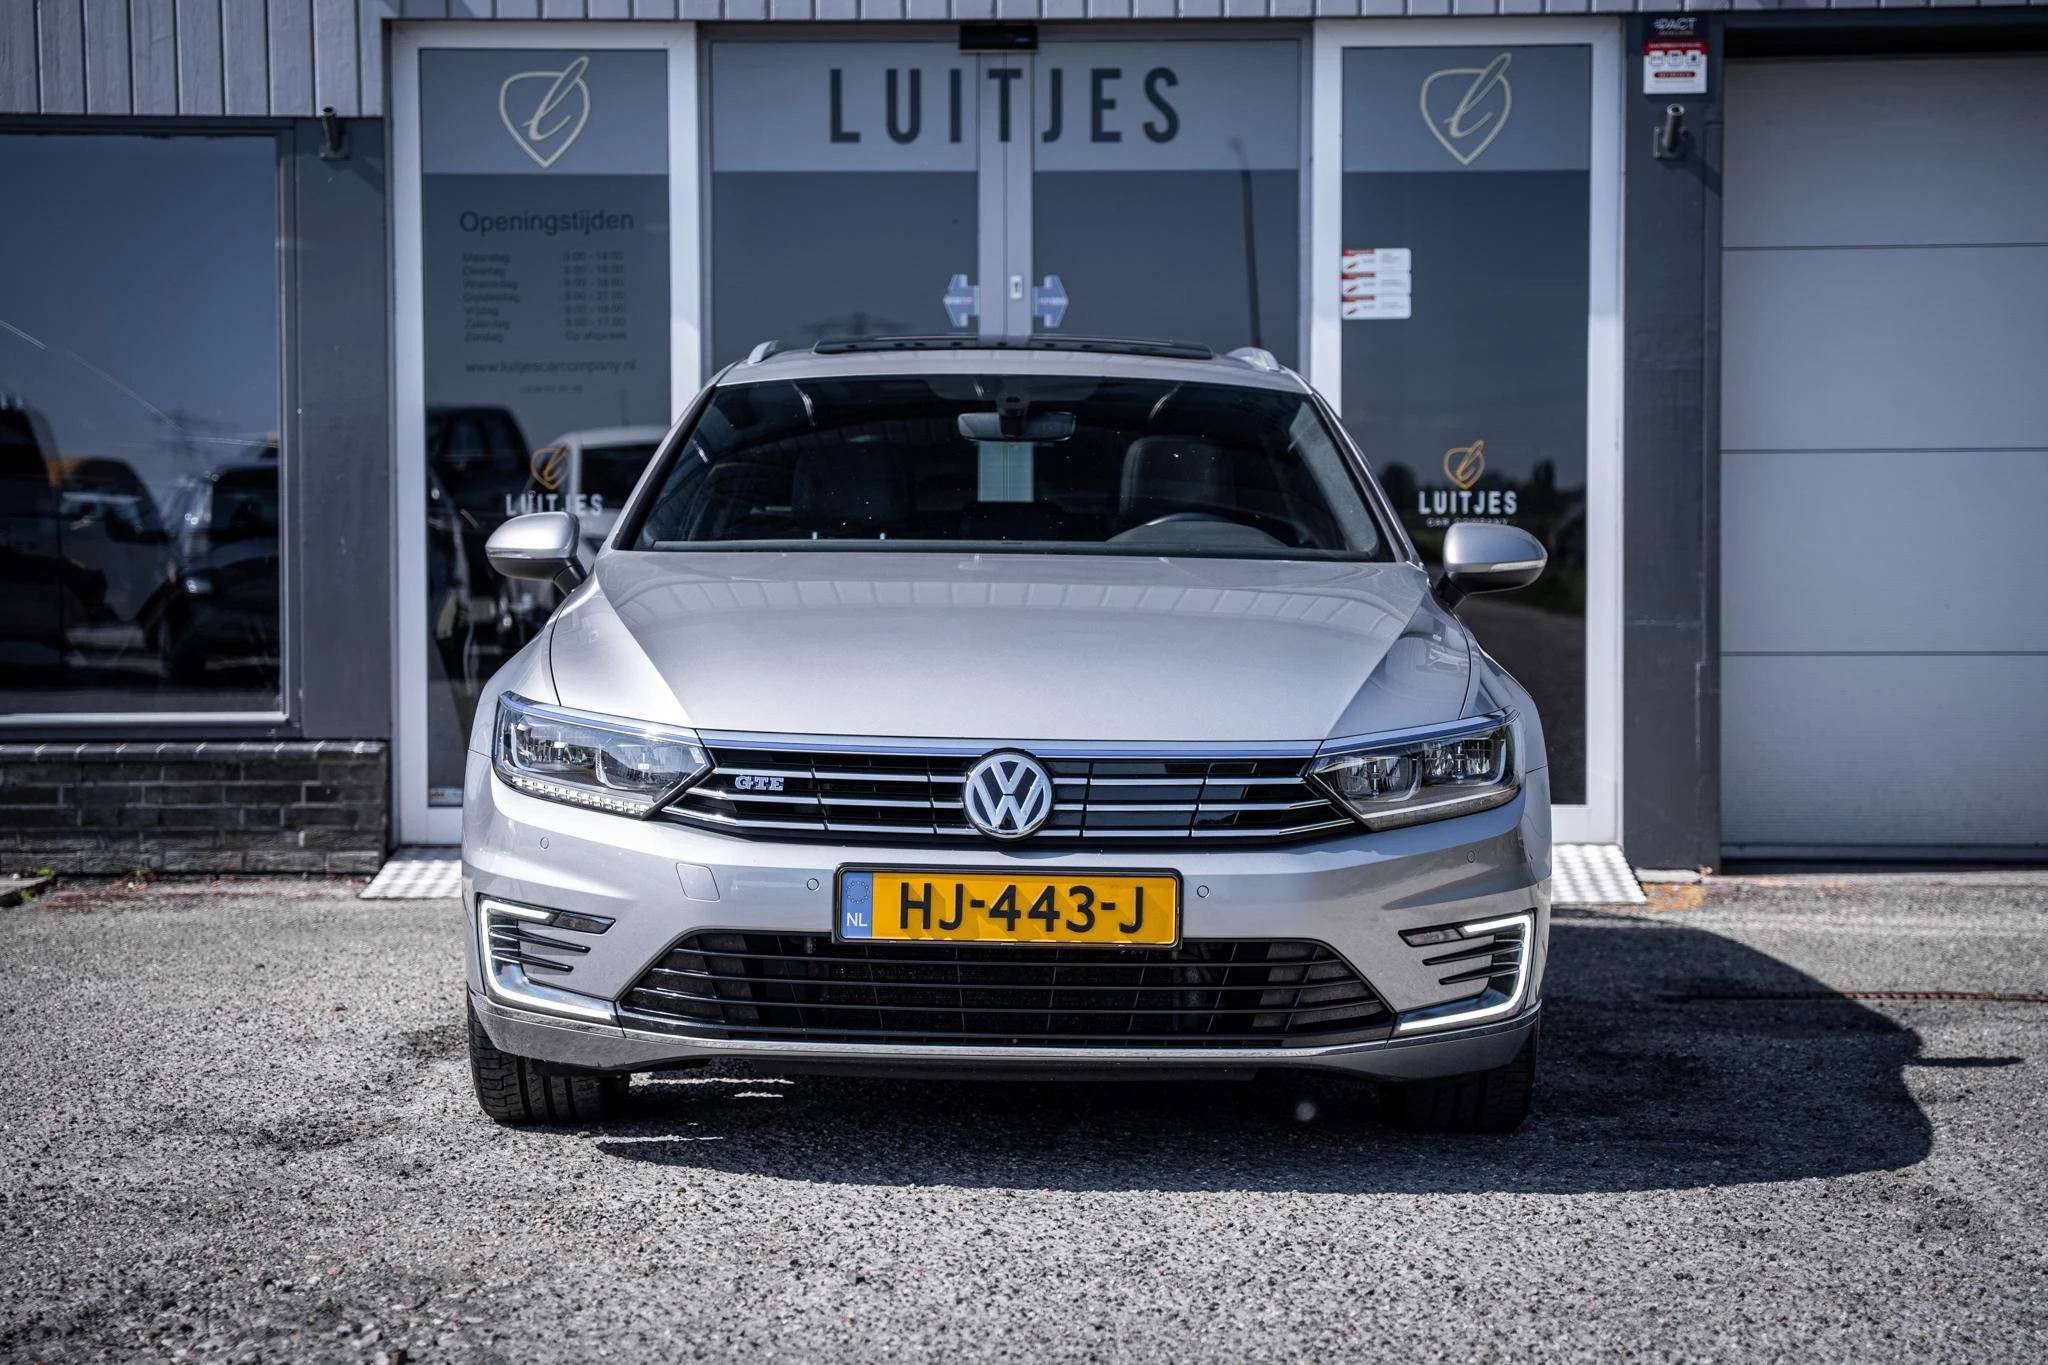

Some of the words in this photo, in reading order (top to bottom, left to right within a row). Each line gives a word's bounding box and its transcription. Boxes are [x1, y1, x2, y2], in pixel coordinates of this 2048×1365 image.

[830, 67, 1181, 145] LUITJES
[459, 210, 635, 237] Openingstijden
[1418, 490, 1518, 515] LUITJES
[734, 775, 785, 791] GTE
[846, 912, 868, 928] NL
[899, 882, 1144, 934] HJ-443-J
